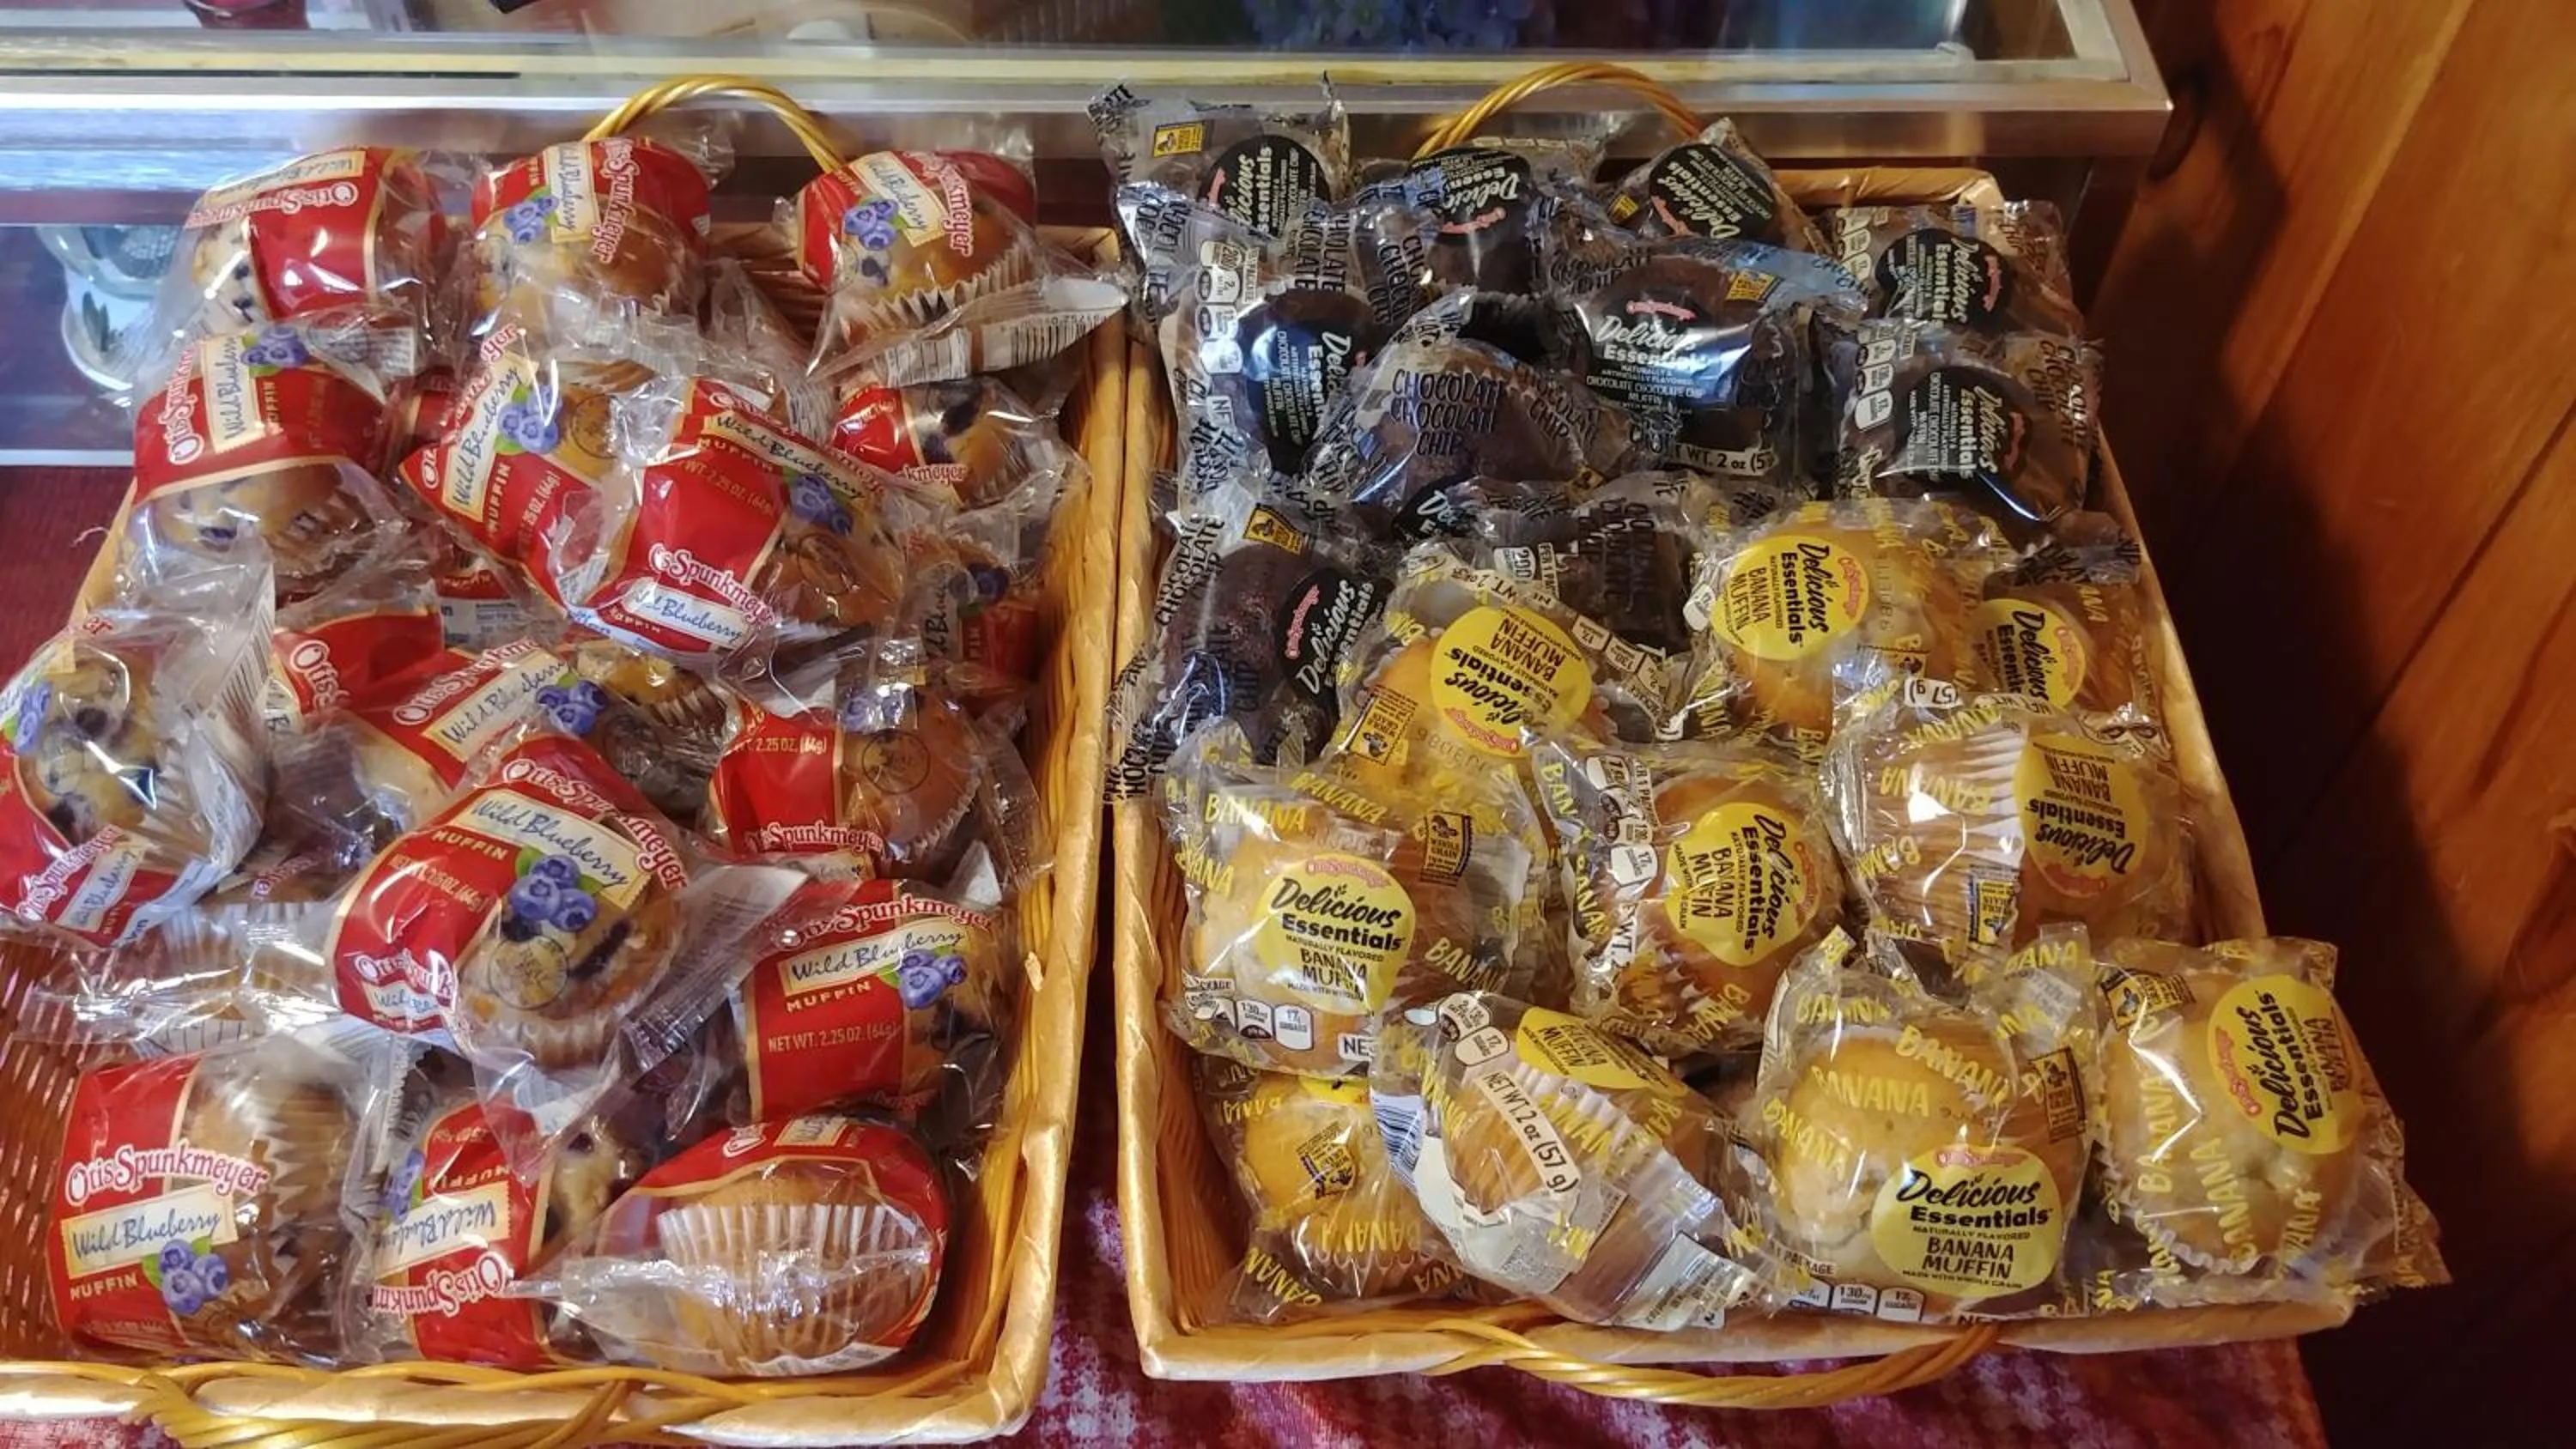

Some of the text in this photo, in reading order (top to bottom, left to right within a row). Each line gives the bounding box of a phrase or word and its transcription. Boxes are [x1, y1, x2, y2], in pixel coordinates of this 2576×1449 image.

[1255, 145, 1274, 234] ssentials
[1716, 453, 1728, 470] 2
[1732, 573, 1752, 631] MUFFIN
[1748, 567, 1772, 623] BANANA
[1781, 551, 1804, 646] Essentials
[1796, 542, 1831, 634] Delicious
[659, 597, 745, 644] Blueberry
[1296, 579, 1358, 695] Delicious
[1490, 630, 1557, 682] BANANA
[1498, 617, 1567, 668] MUFFIN
[2011, 609, 2050, 702] Delicious
[2044, 753, 2109, 782] MUFFIN
[2056, 775, 2111, 802] BANANA
[1205, 792, 1308, 832] BANANA
[1291, 772, 1388, 824] BANANA
[2029, 797, 2125, 840] Essentials
[432, 829, 509, 861] MUFFIN
[472, 799, 629, 888] Wild Blueberry
[2034, 822, 2136, 875] Delicious
[1710, 846, 1735, 919] BANANA
[1741, 826, 1767, 951] Essentials
[1753, 813, 1793, 941] Delicious
[1270, 876, 1403, 930] Delicious
[1281, 912, 1406, 952] Essentials
[791, 953, 854, 984] Wild
[786, 982, 872, 1014] MUFFIN
[2236, 1005, 2311, 1140] Delicious
[2258, 991, 2324, 1121] Essentials
[1483, 1072, 1515, 1094] NET
[1502, 1090, 1531, 1117] WT.
[1516, 1110, 1538, 1125] 2
[1523, 1125, 1542, 1141] oz
[1533, 1141, 1568, 1169] (57
[1546, 1173, 1581, 1193] g)
[1896, 1169, 2041, 1208] Delicious
[73, 1209, 222, 1260] Wild Blueberry
[1910, 1204, 2049, 1230] Essentials
[1976, 1230, 2032, 1242] FLAVORED
[1920, 1254, 2013, 1280] MUFFIN
[1925, 1235, 2015, 1263] BANANA
[69, 1271, 141, 1302] MUFFIN
